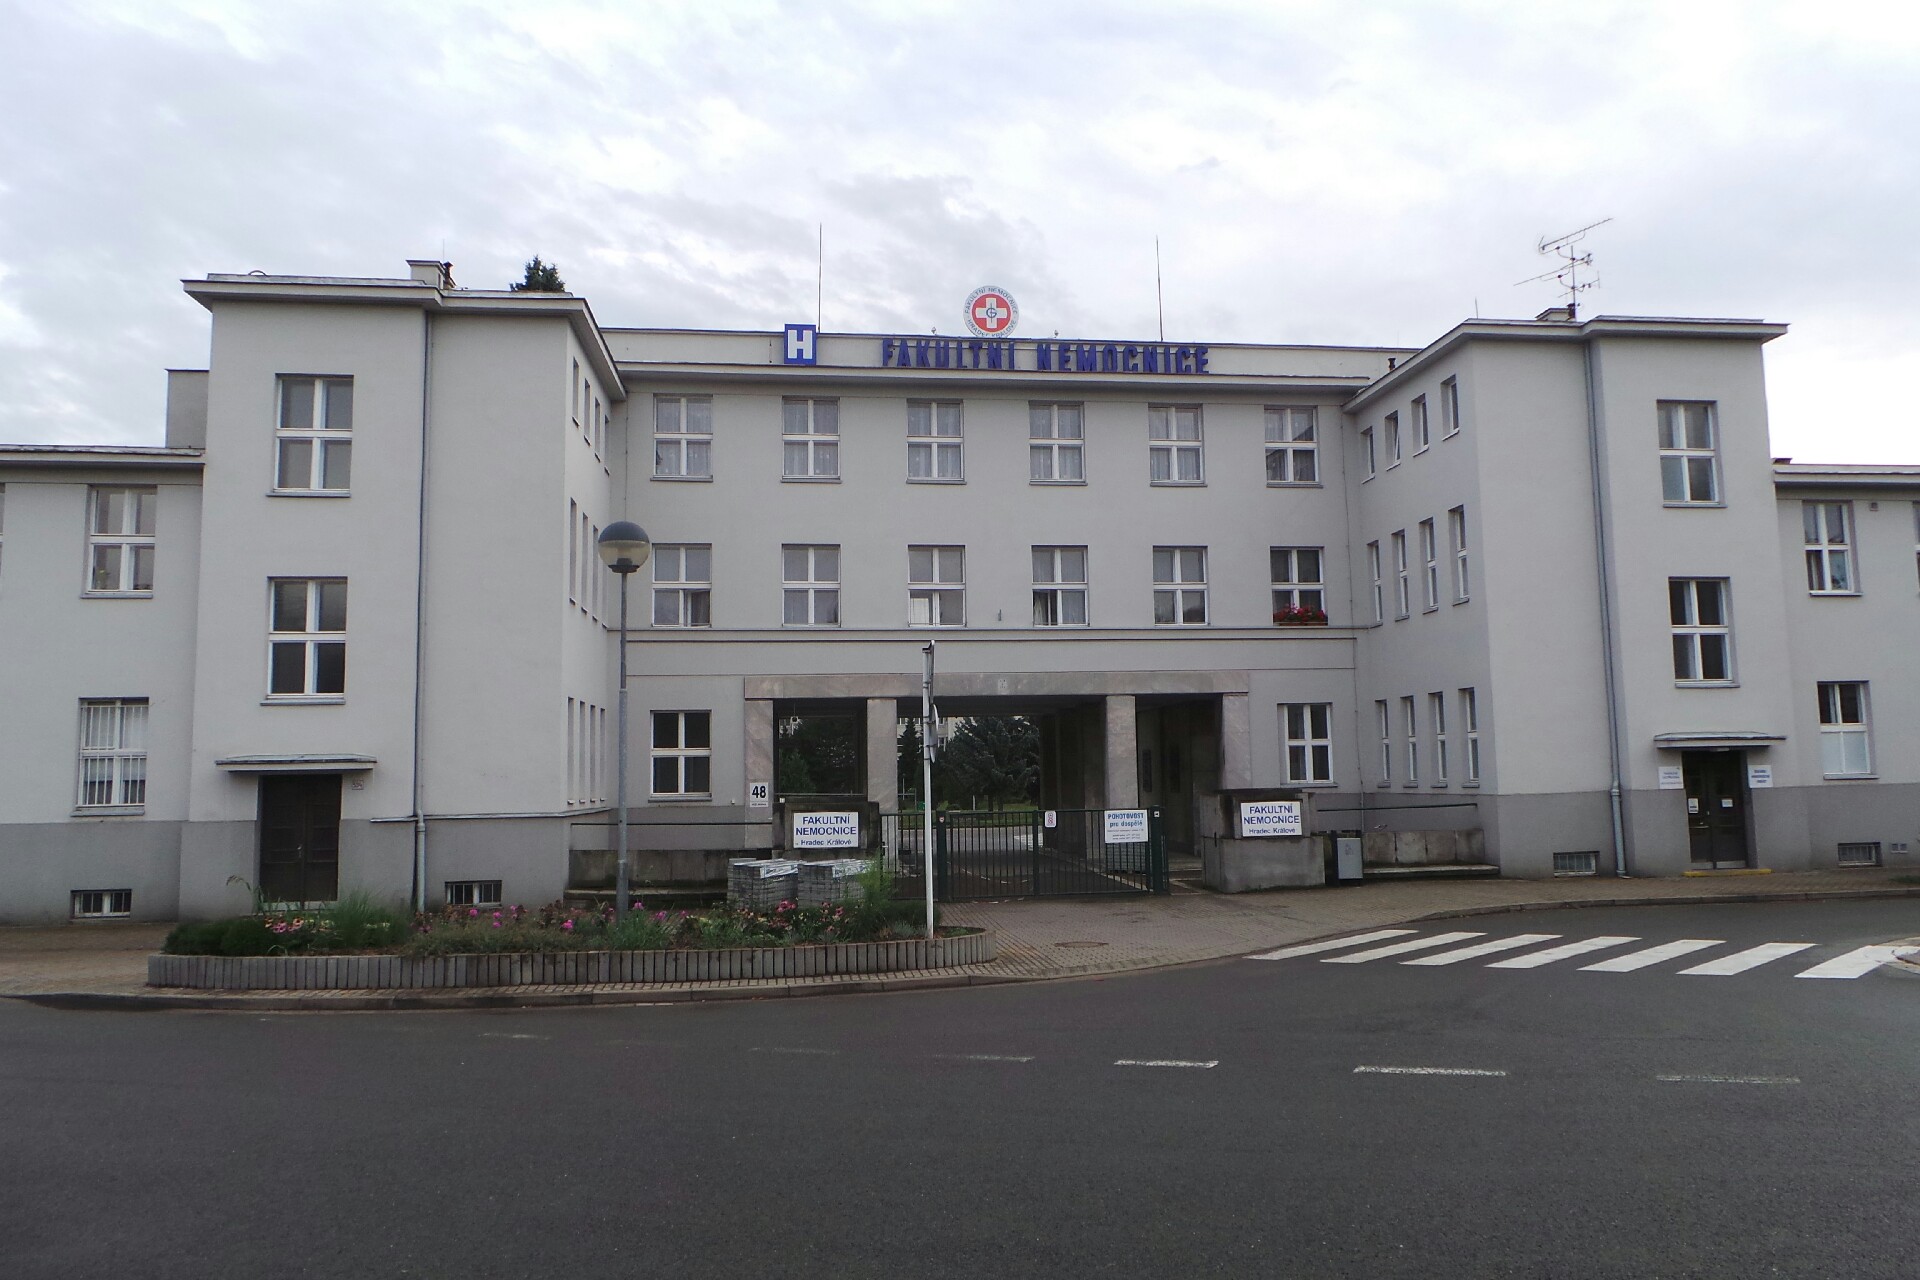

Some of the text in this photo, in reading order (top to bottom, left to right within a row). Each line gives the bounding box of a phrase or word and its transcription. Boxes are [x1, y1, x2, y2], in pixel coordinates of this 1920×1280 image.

[787, 329, 813, 360] H
[1036, 343, 1210, 374] NEMOCNICE
[751, 785, 766, 798] 48
[1249, 803, 1293, 814] FAKULTNÍ
[802, 814, 850, 825] FAKULTNÍ
[1107, 812, 1144, 820] POHOTOVOST
[1243, 815, 1300, 825] NEMOCNICE
[795, 826, 857, 836] NEMOCNICE
[826, 838, 852, 846] Králové
